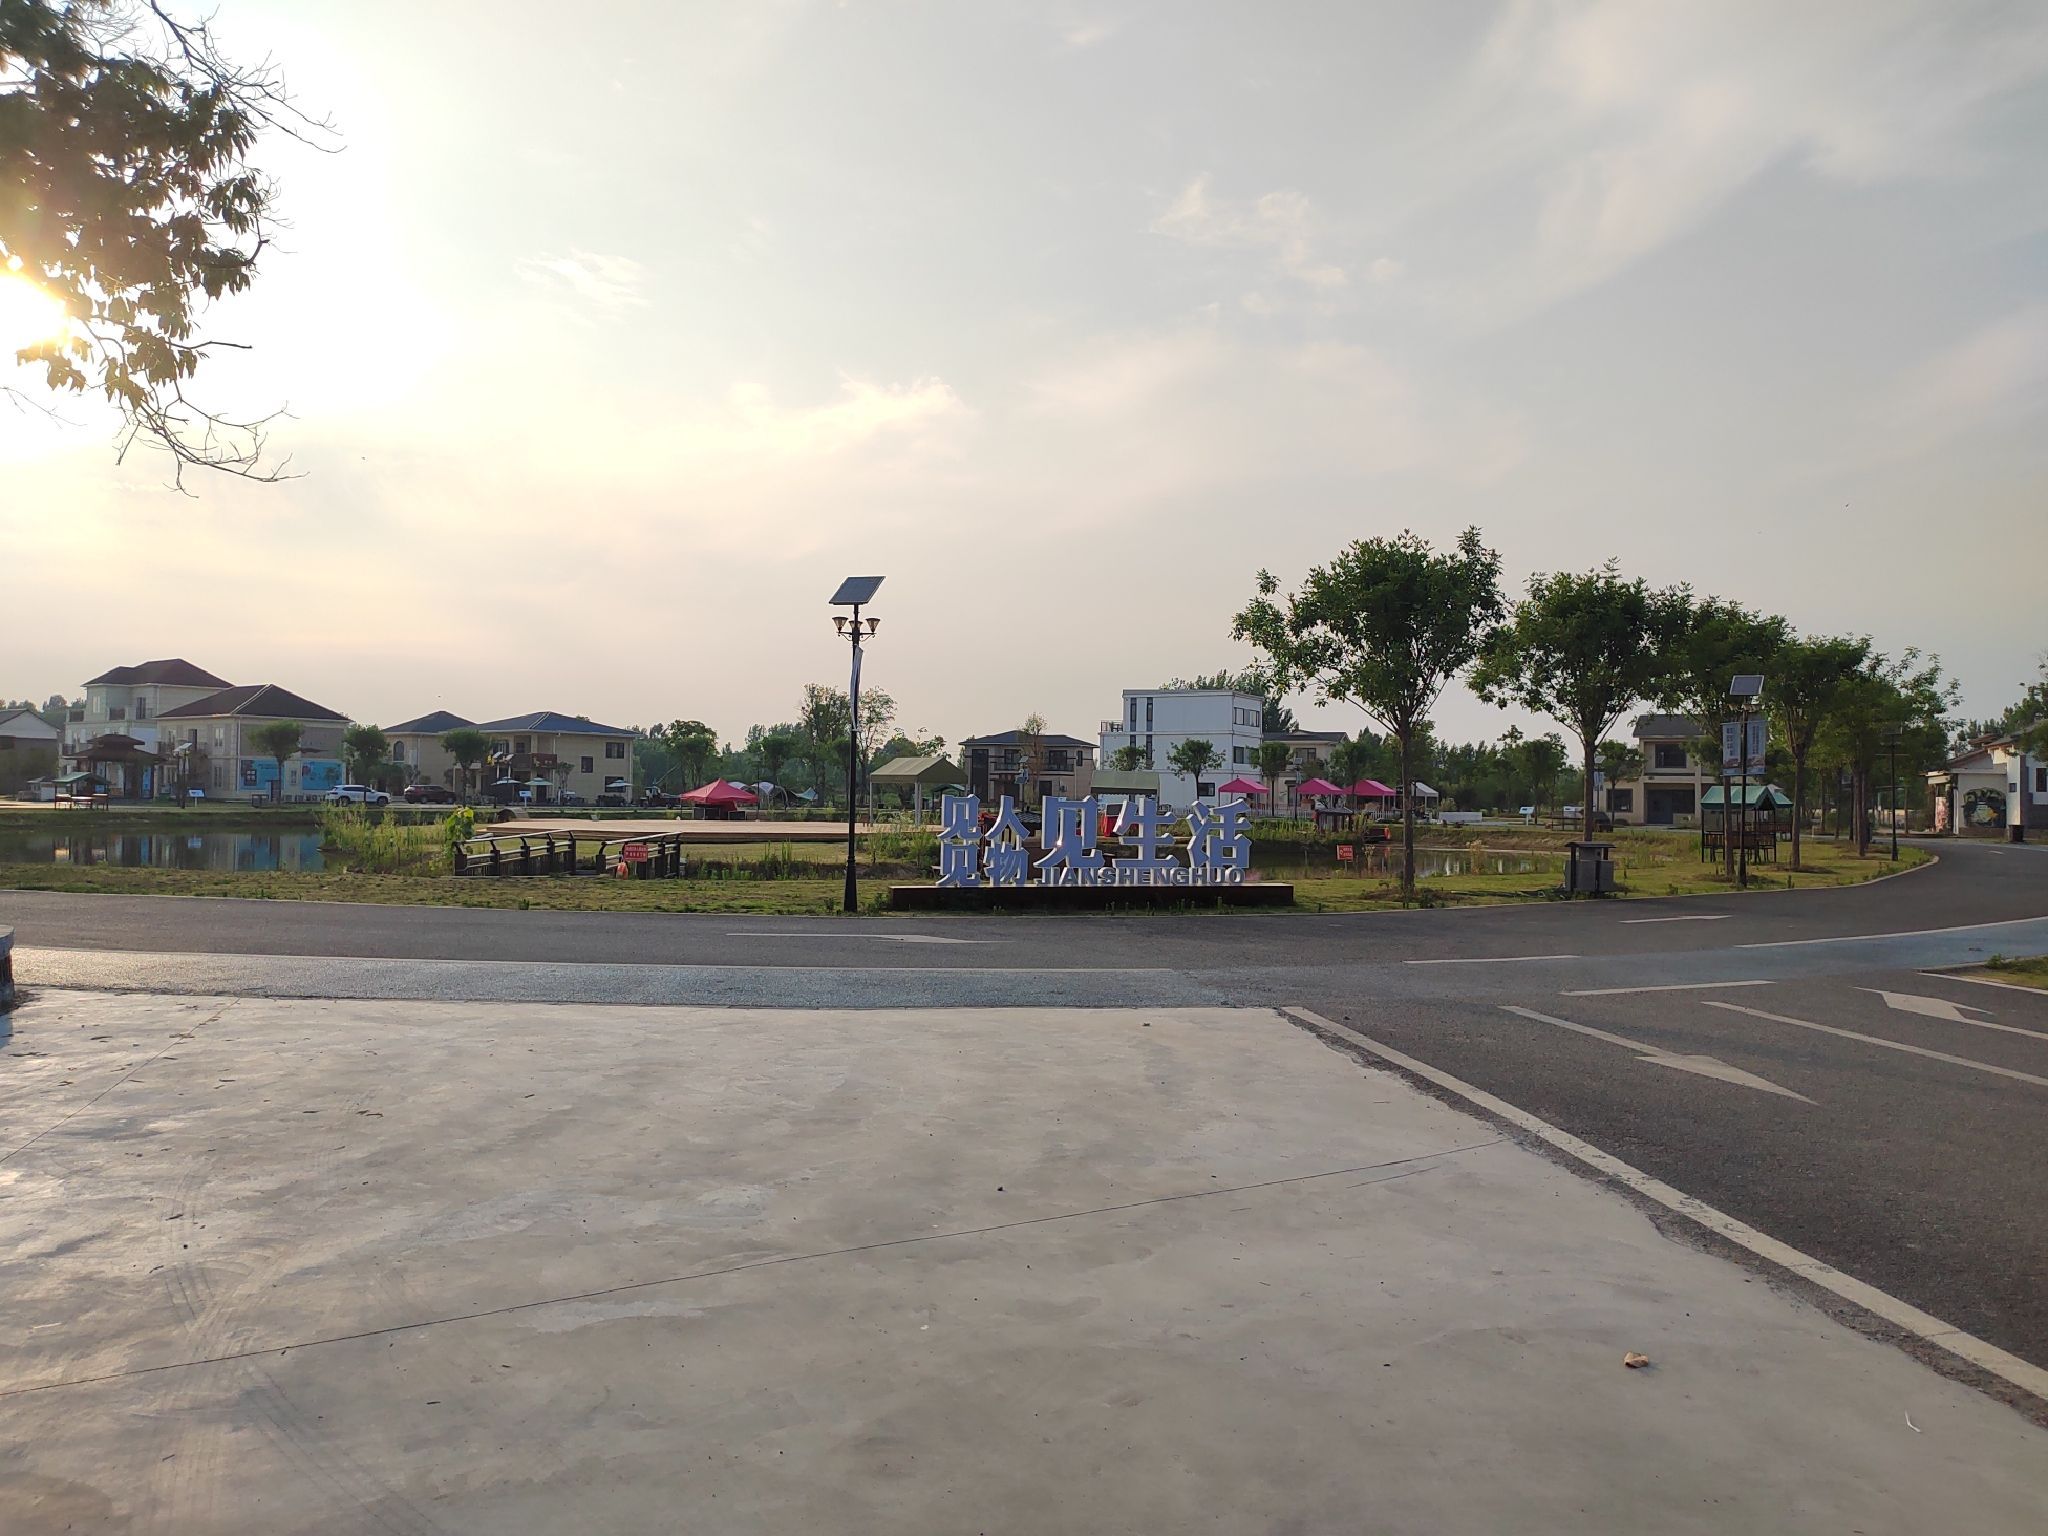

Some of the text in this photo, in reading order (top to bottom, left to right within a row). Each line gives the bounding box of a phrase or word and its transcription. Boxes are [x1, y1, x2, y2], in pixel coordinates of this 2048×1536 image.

[936, 794, 1030, 841] 见人
[1033, 796, 1252, 868] 见生活
[936, 840, 1029, 887] 见物
[1034, 867, 1246, 886] JIANSHENGHUO
